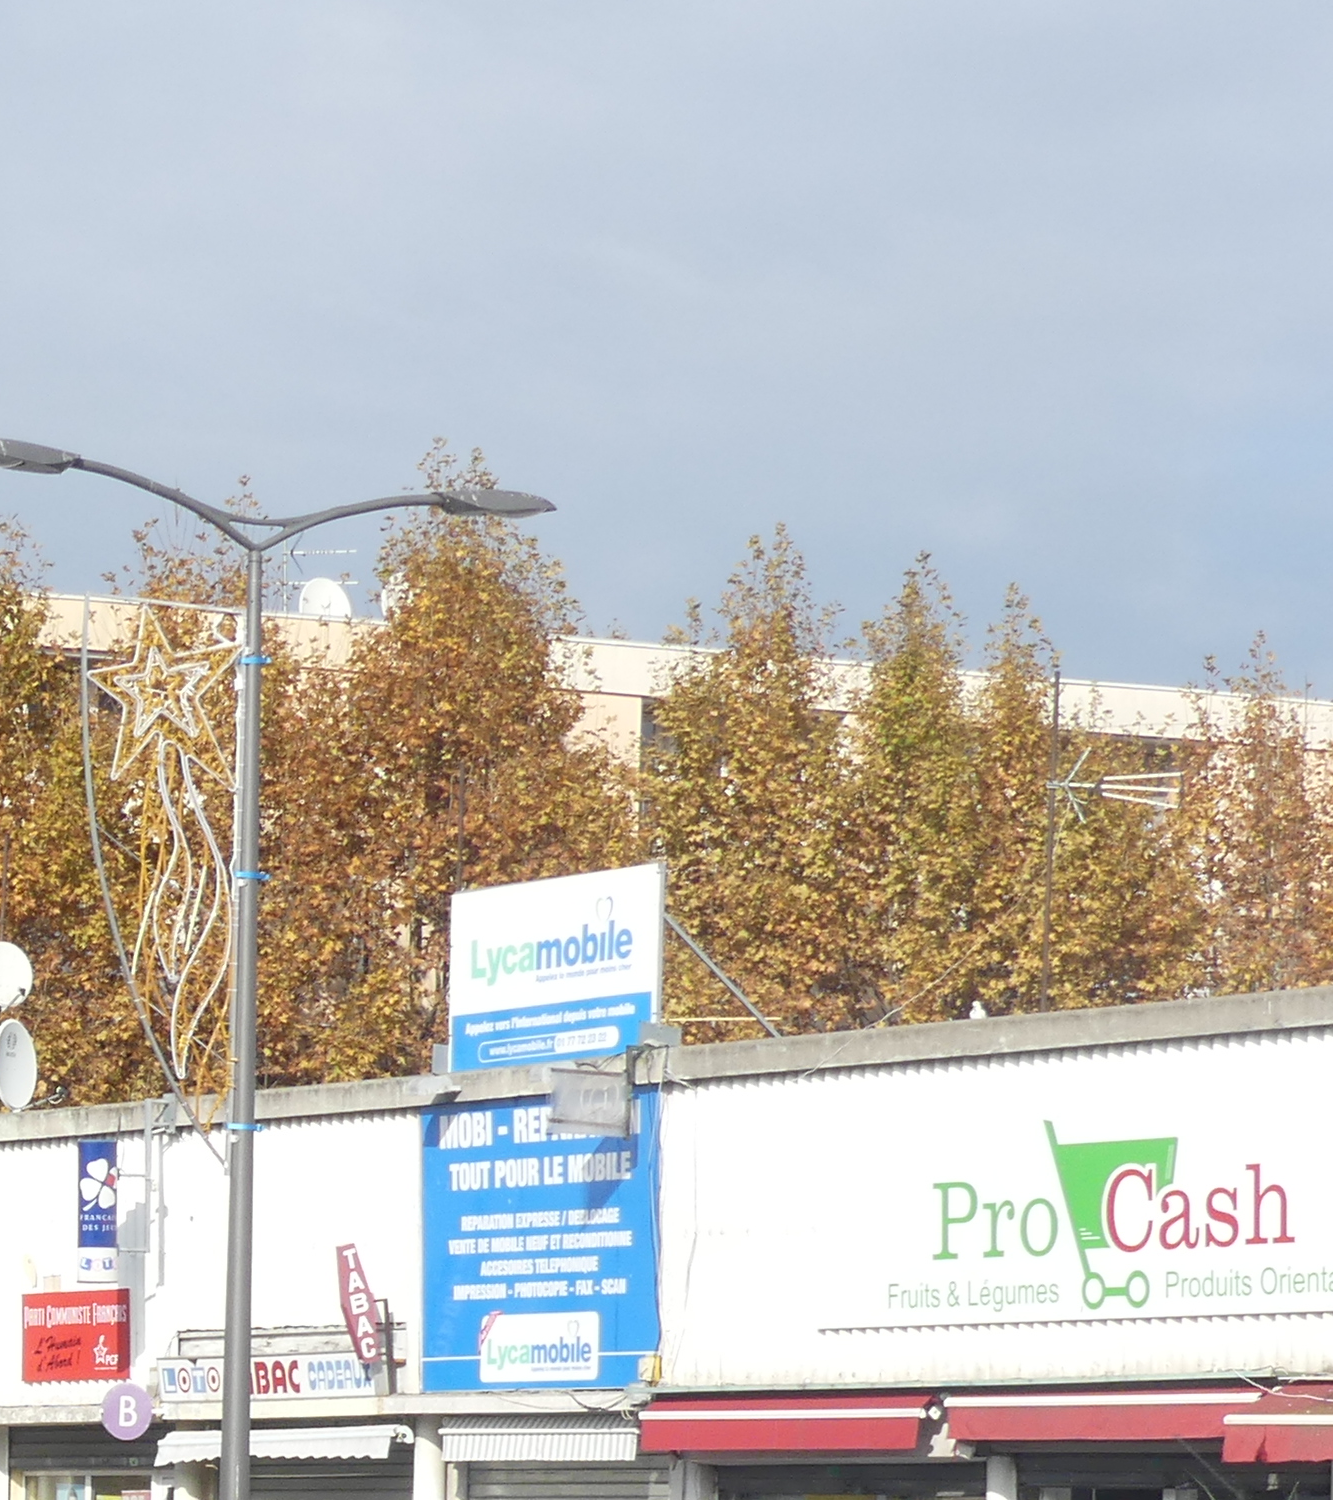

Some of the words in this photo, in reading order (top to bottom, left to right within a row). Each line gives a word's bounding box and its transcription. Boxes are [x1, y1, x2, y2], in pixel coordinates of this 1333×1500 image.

[471, 920, 633, 986] Lycamobile
[465, 1022, 494, 1037] Appelez
[495, 1019, 510, 1030] vers
[563, 1008, 586, 1024] depuis
[587, 1006, 607, 1019] votre
[608, 1002, 635, 1016] mobile
[566, 1036, 575, 1046] 77
[439, 1112, 493, 1150] MOBI
[449, 1160, 491, 1191] TOUT
[495, 1158, 539, 1188] POUR
[543, 1156, 564, 1186] LE
[568, 1151, 632, 1183] MOBILE
[461, 1215, 514, 1231] REPARATION
[515, 1211, 561, 1228] EXPRESSE
[568, 1207, 620, 1225] DEBLOCAGE
[932, 1182, 1059, 1260] Pro
[1106, 1164, 1296, 1253] Cash
[448, 1239, 476, 1255] VENTE
[477, 1238, 490, 1253] DE
[491, 1236, 524, 1253] MOBILE
[526, 1235, 548, 1252] NEUF
[550, 1234, 561, 1250] ET
[562, 1230, 632, 1249] RECONDITIONNE
[534, 1255, 599, 1274] TELEPHONIQUE
[453, 1283, 507, 1300] IMPRESSION
[514, 1281, 568, 1298] PHOTOCOPIE
[575, 1279, 593, 1295] FAX
[601, 1278, 627, 1294] SCAN
[887, 1282, 941, 1309] Fruits
[946, 1281, 961, 1307] &
[967, 1278, 1060, 1313] Légumes
[1164, 1268, 1253, 1299] Produits
[342, 1248, 376, 1359] TABAC
[106, 1354, 118, 1365] PCF
[487, 1336, 592, 1370] Lycamobile
[162, 1366, 221, 1393] LOTO
[307, 1360, 372, 1391] CADEAUX
[118, 1395, 138, 1427] B
